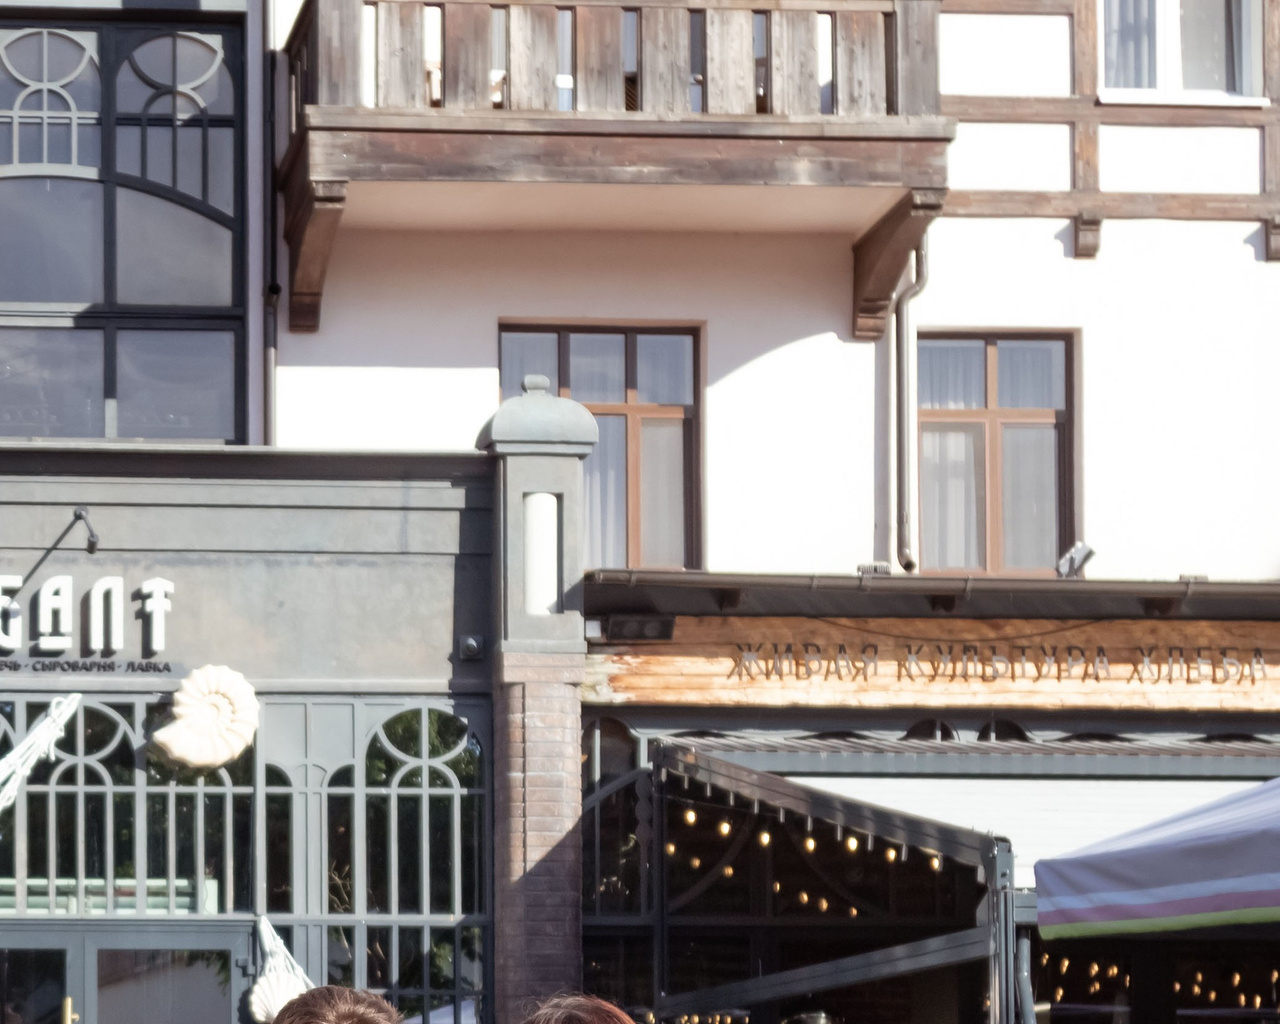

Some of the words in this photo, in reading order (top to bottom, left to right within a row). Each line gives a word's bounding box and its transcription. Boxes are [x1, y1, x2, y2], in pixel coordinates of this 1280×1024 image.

[32, 660, 116, 673] СЫРОВАРНЯ
[125, 661, 172, 673] ЛАВКА
[735, 643, 878, 678] ЖИВАЯ
[906, 643, 1111, 679] КУЛЬТУРА
[1135, 645, 1268, 680] ХЛЕБА
